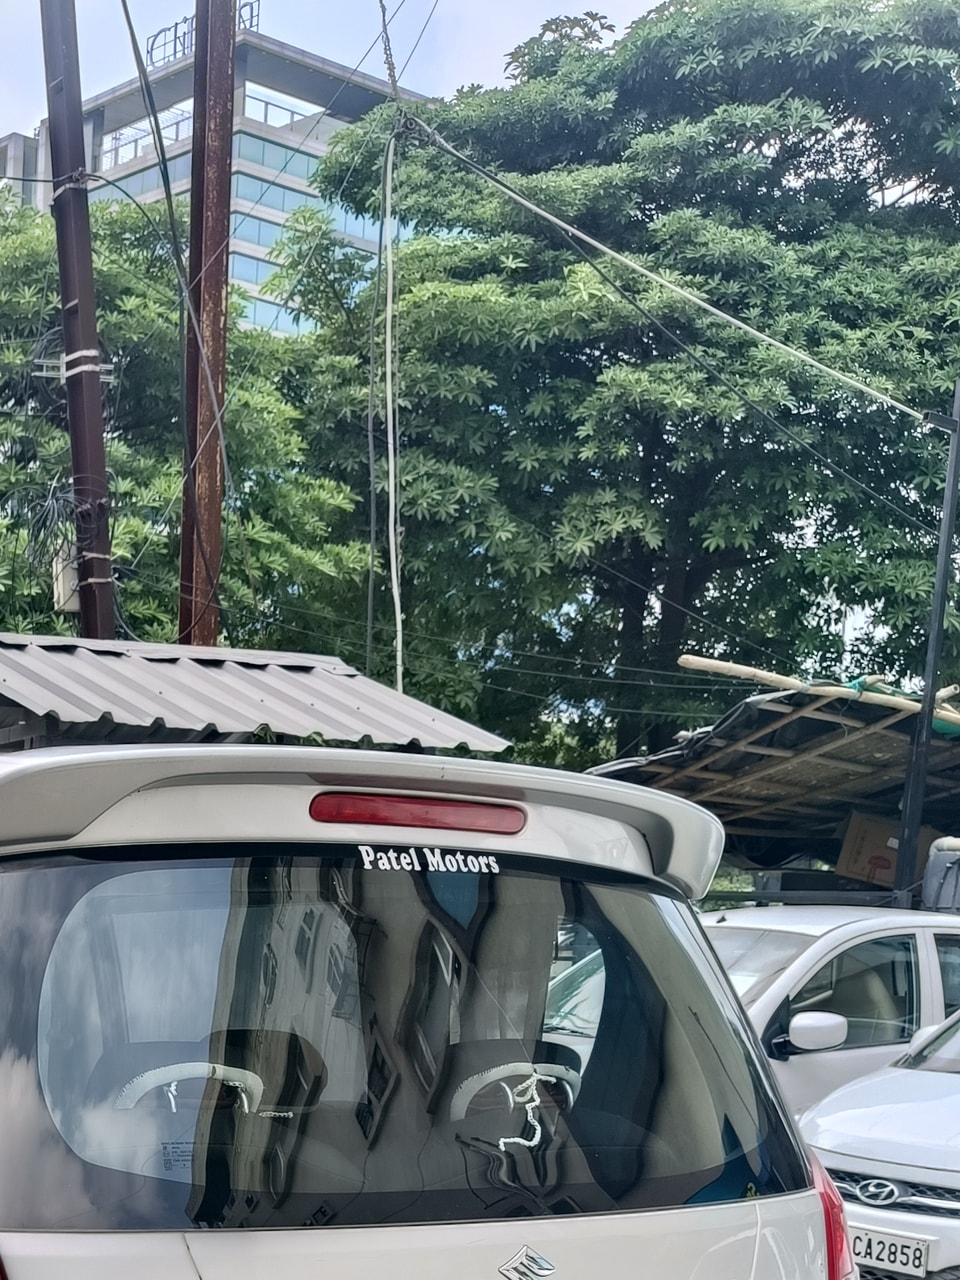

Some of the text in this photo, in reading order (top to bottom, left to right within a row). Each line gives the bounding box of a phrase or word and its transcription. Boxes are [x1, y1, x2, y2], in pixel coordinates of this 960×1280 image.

[358, 845, 500, 874] Patel Motors
[852, 1236, 923, 1269] CA2858
